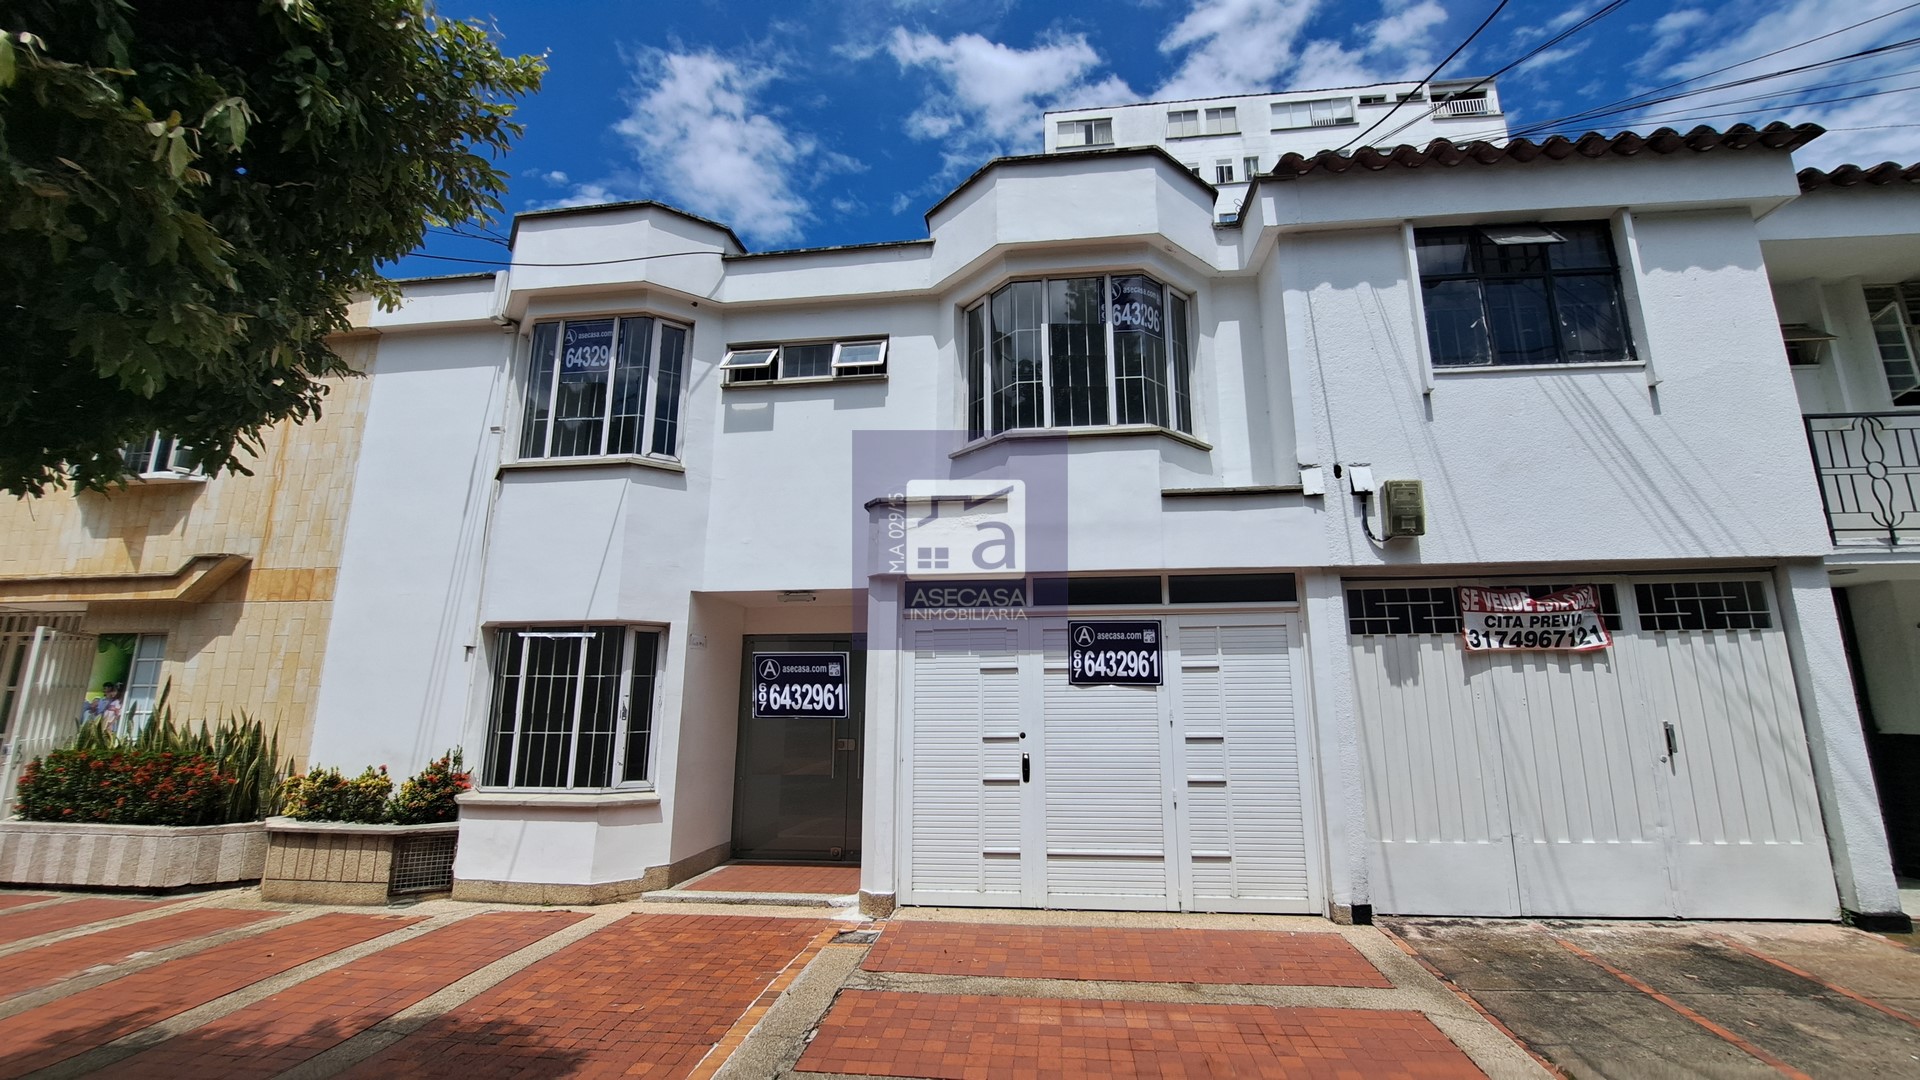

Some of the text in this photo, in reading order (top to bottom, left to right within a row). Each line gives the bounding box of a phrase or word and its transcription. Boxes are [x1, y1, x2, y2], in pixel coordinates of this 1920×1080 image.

[1123, 286, 1157, 299] asecasa.com
[578, 331, 613, 339] asecasa.com
[565, 344, 623, 368] 643291
[1461, 588, 1479, 611] SE
[1482, 591, 1534, 612] VENDE
[1484, 613, 1582, 628] CITA PREVIA
[1097, 632, 1142, 640] asecasa.com
[1469, 624, 1604, 649] 3174967121
[782, 665, 827, 673] asecasa.com
[1084, 650, 1158, 677] 6432961
[769, 683, 843, 710] 6432961
